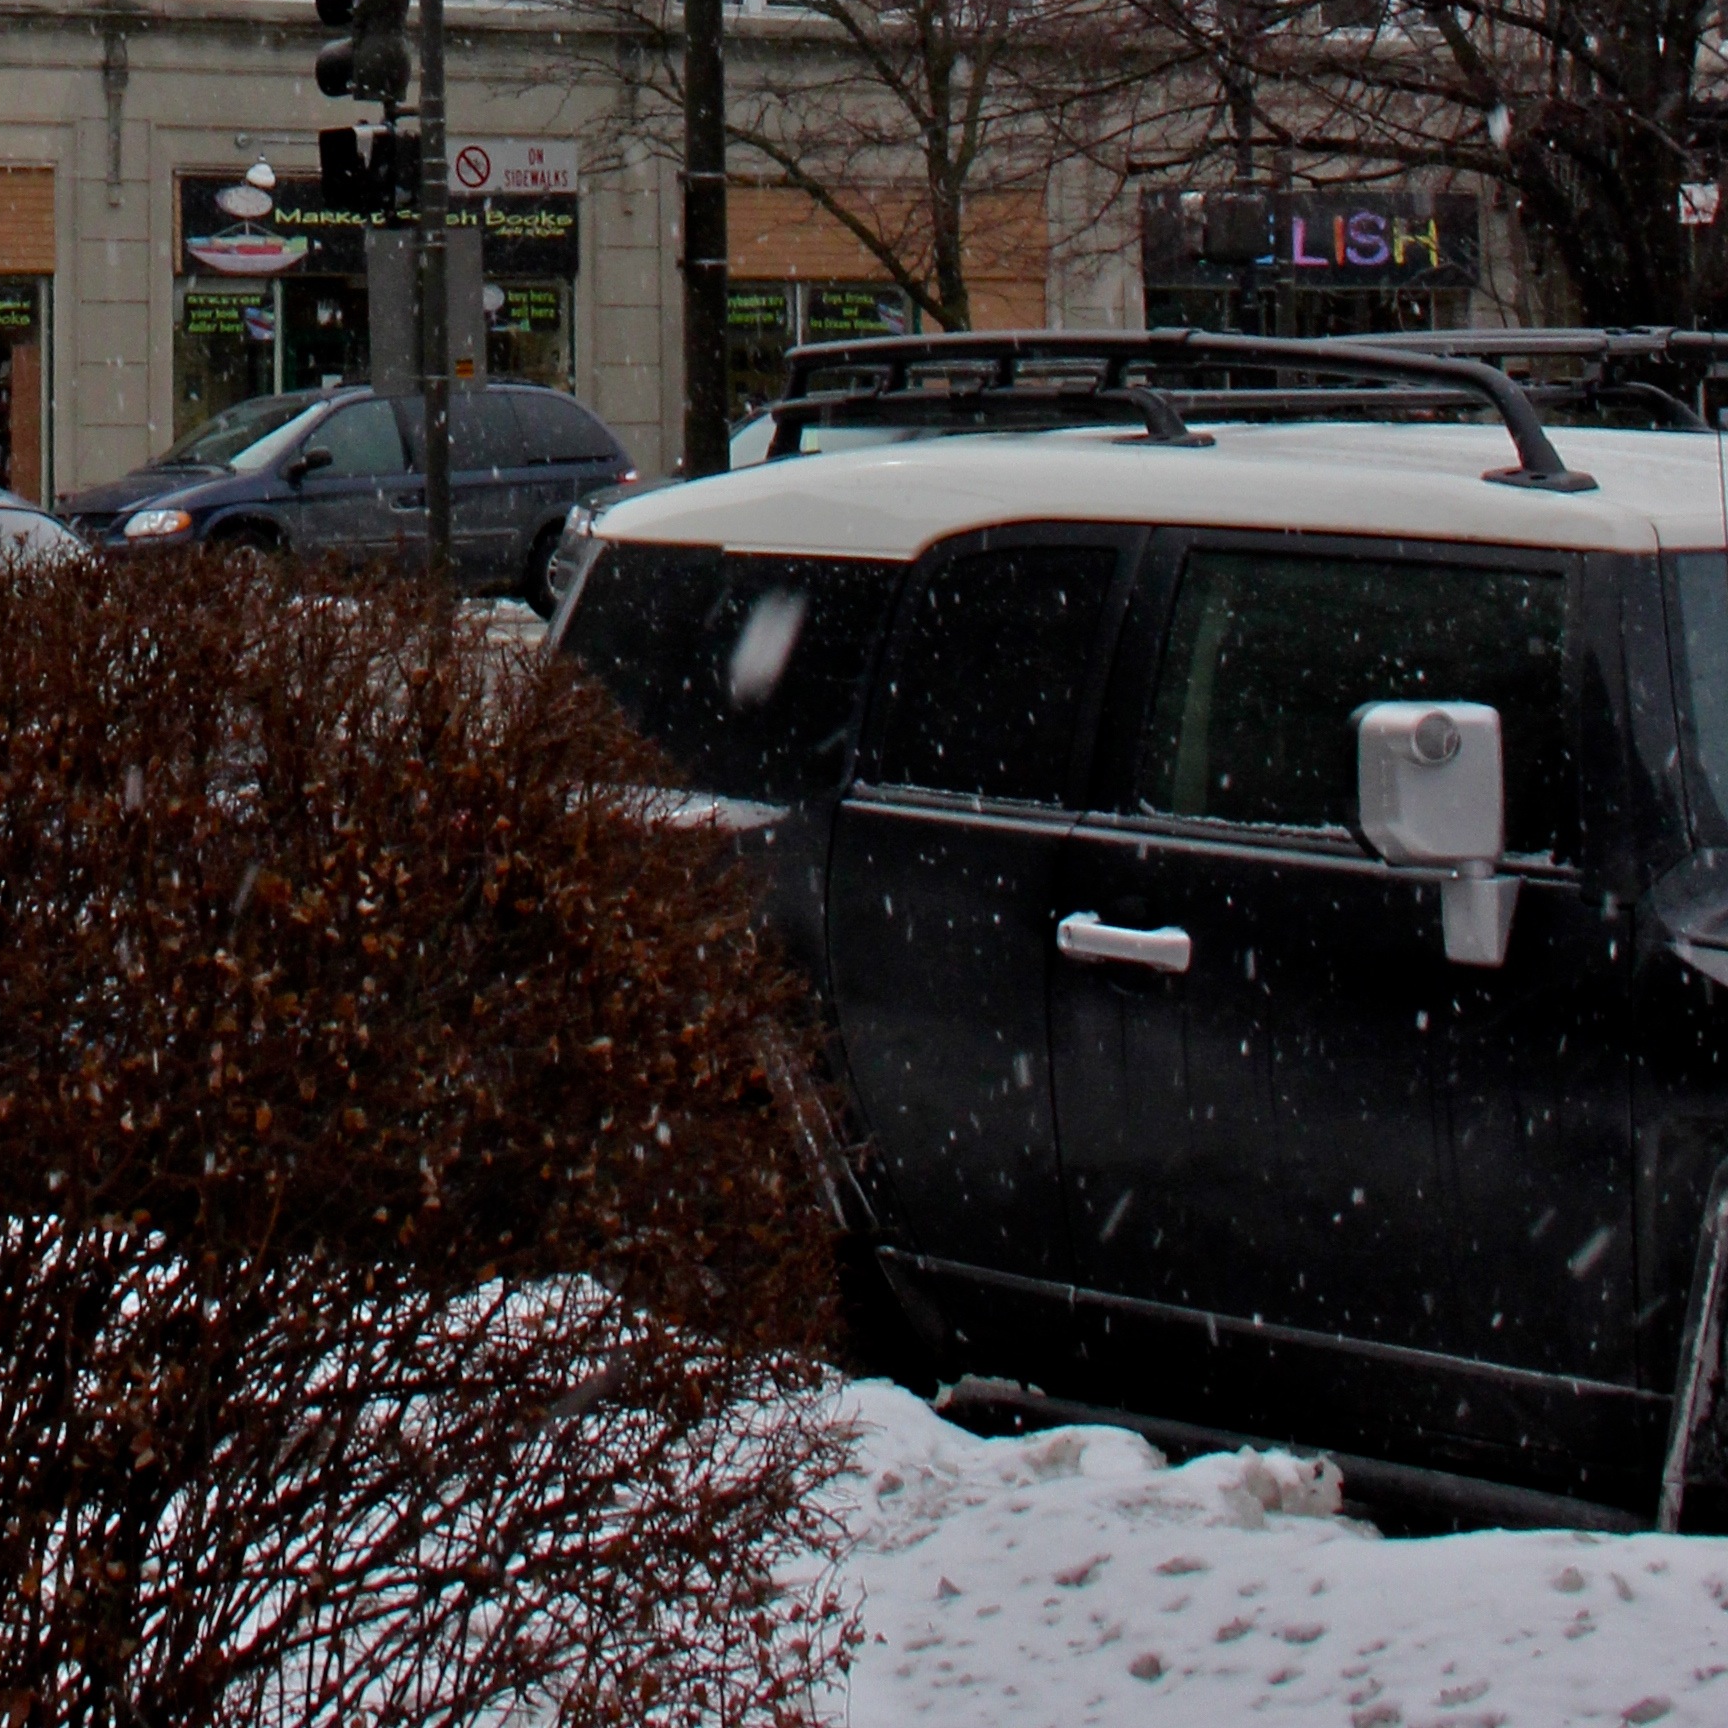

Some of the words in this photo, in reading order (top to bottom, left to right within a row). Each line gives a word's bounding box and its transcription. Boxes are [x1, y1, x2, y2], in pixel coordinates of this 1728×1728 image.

[527, 147, 544, 165] ON
[503, 168, 569, 188] SIDEWALKS
[485, 209, 574, 227] Books
